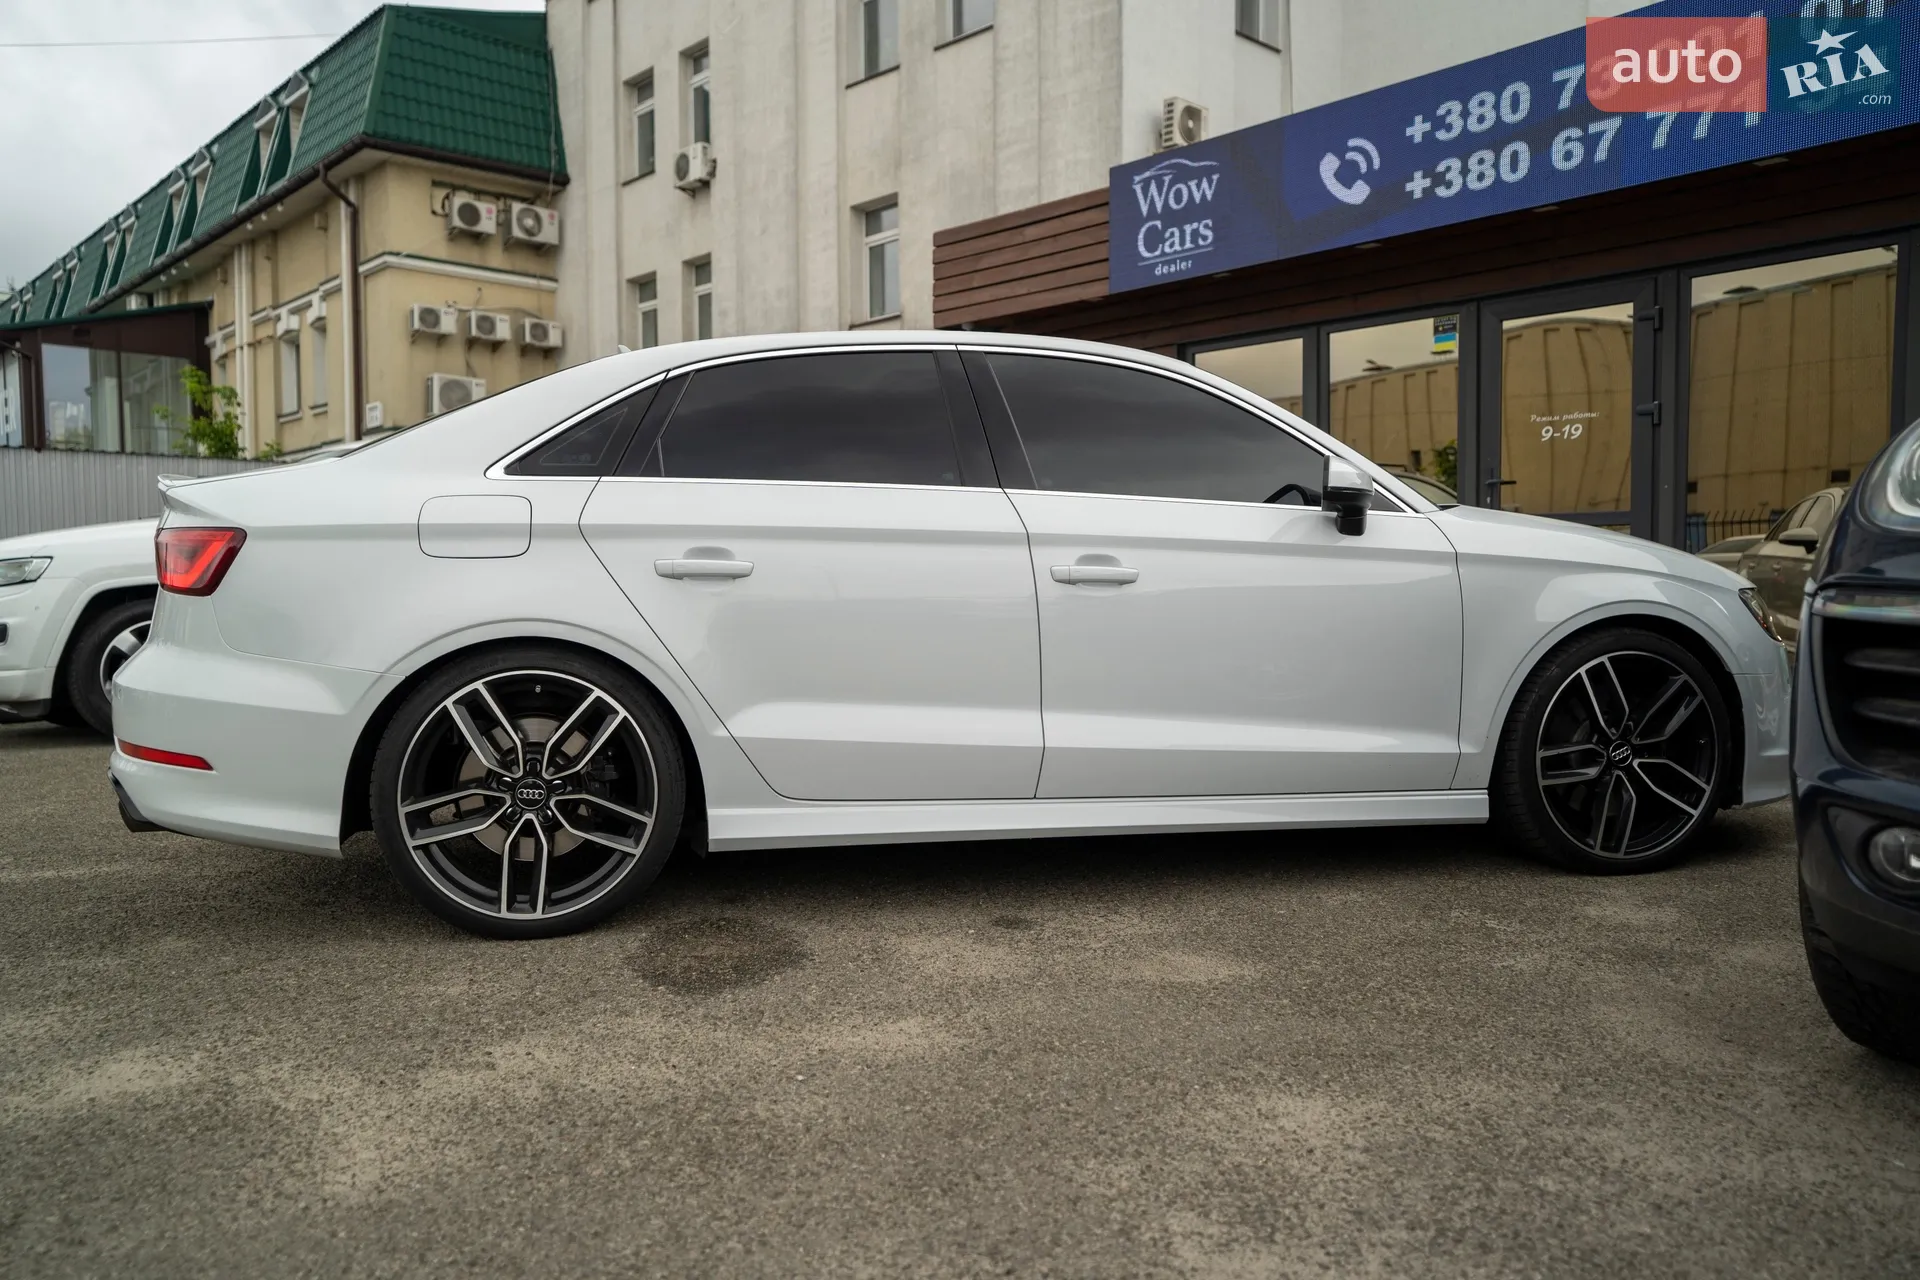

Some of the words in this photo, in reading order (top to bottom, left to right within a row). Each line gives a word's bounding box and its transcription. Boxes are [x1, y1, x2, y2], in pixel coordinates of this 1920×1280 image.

[1405, 81, 1531, 144] +380
[1405, 140, 1531, 200] +380
[1551, 116, 1623, 171] 67
[1132, 173, 1220, 218] Wow
[1137, 218, 1214, 258] Cars
[1154, 259, 1193, 276] dealer
[1530, 414, 1560, 422] Режим
[1540, 423, 1583, 442] 9-19
